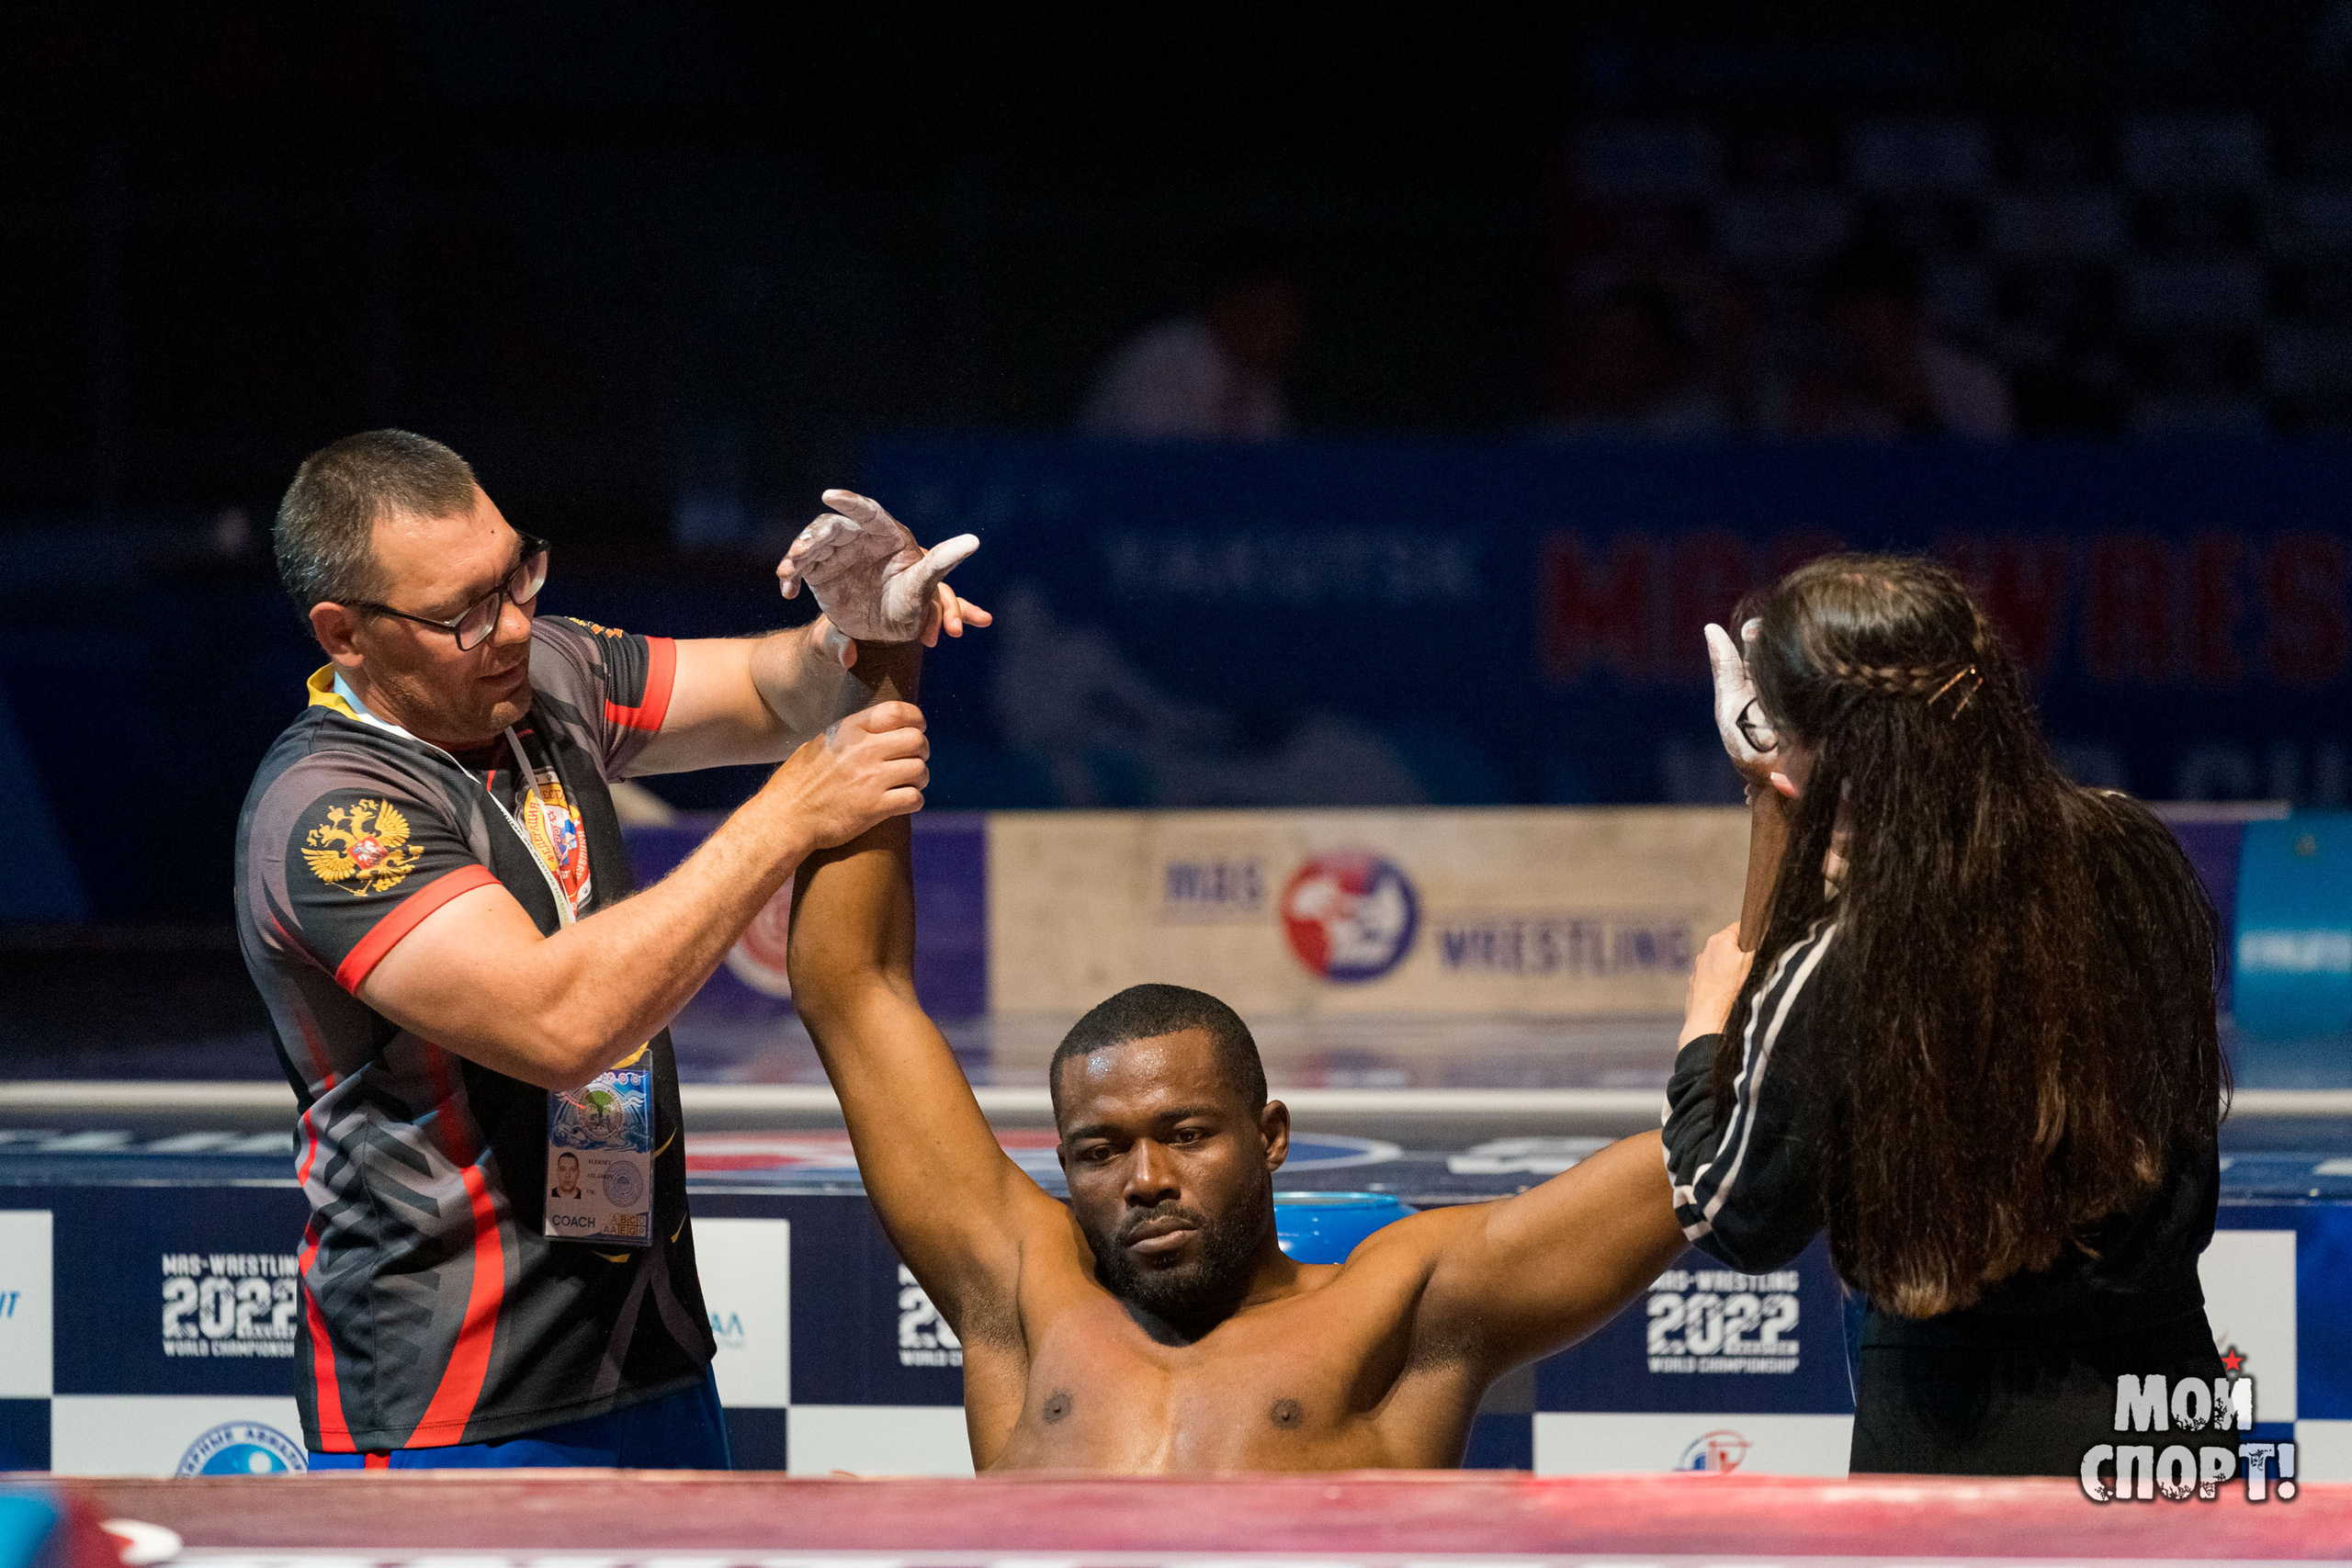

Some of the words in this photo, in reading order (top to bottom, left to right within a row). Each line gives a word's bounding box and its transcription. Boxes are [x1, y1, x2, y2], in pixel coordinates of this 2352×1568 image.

[527, 802, 555, 863] ФЕДЕРАЦИЯ
[1438, 924, 1692, 976] WRESTLING
[552, 1214, 596, 1228] COACH
[162, 1276, 298, 1339] 2022
[1646, 1292, 1800, 1356] 2022
[1647, 1356, 1697, 1373] WORLD
[1698, 1356, 1800, 1373] CHAMPIONSHIP
